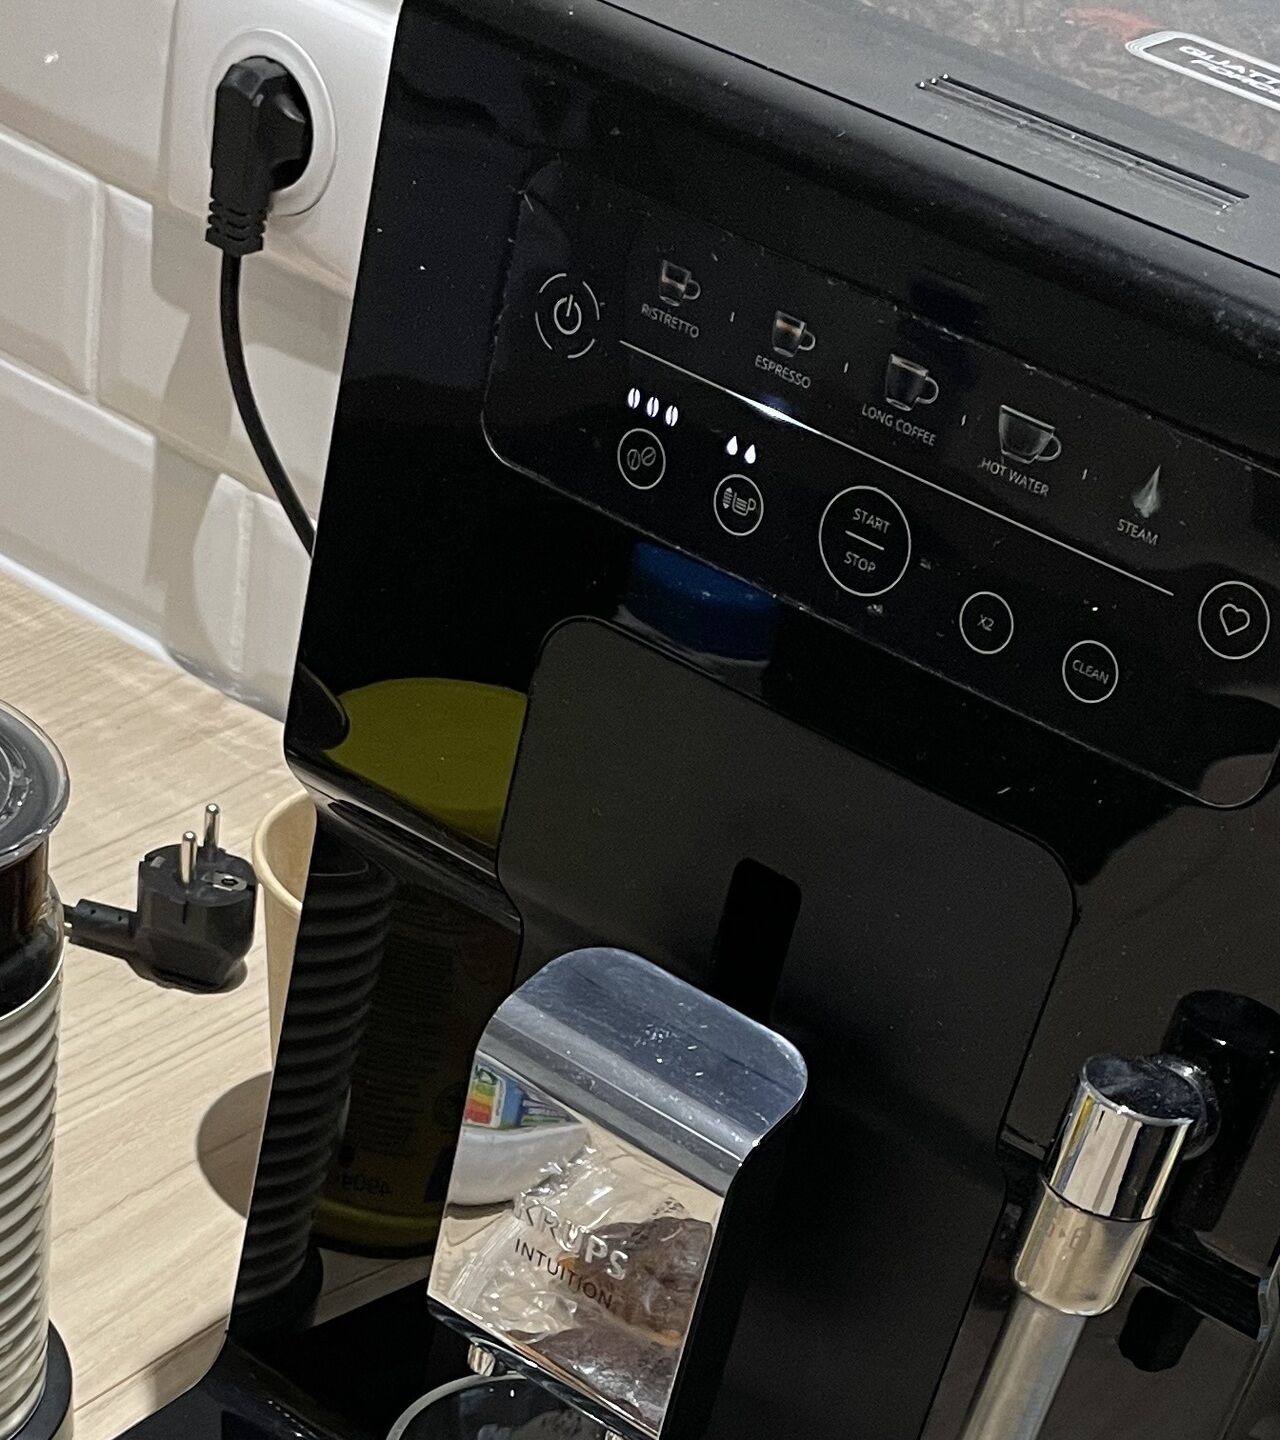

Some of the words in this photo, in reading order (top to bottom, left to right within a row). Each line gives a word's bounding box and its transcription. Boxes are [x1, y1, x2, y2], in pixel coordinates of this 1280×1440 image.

[641, 303, 700, 338] RISTRETTO
[755, 354, 811, 389] ESPRESSO
[862, 404, 901, 431] LONG
[897, 418, 937, 447] COFFEE
[980, 457, 1009, 480] HOT
[1004, 465, 1050, 497] WATER
[852, 507, 891, 534] START
[1118, 518, 1159, 546] STEAM
[844, 551, 877, 574] STOP
[1073, 658, 1109, 685] CLEAN
[515, 1239, 612, 1309] INTUITION
